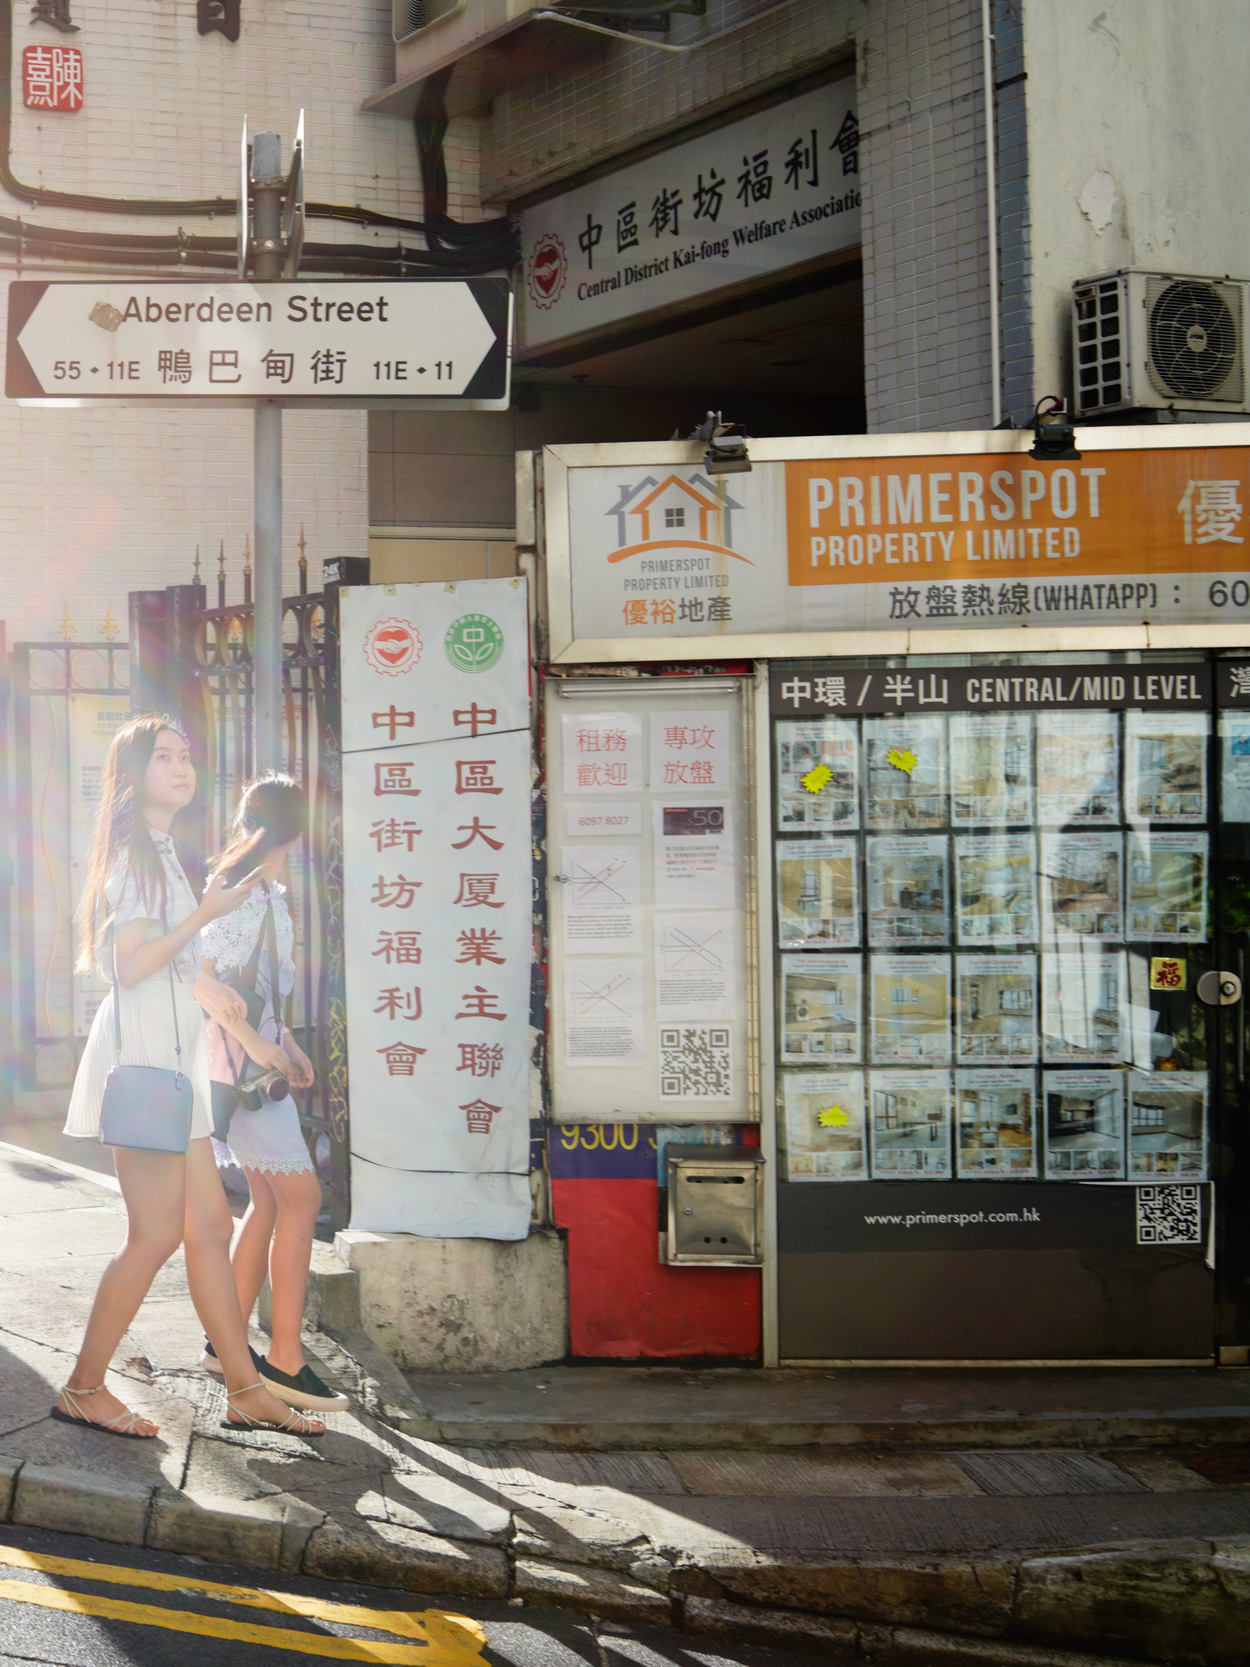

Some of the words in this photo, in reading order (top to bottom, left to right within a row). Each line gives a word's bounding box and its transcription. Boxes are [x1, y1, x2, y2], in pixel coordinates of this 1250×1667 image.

[577, 110, 859, 270] 中區街坊福利會
[577, 270, 621, 301] Central
[624, 257, 670, 286] District
[672, 238, 729, 270] Kai-fong
[732, 218, 787, 248] Welfare
[789, 189, 862, 230] Associatio
[122, 295, 273, 323] Aberdeen
[287, 294, 389, 323] Street
[53, 360, 82, 380] 55
[106, 360, 141, 380] 11E
[157, 348, 348, 385] 鴨巴甸街
[373, 360, 408, 380] 11E
[435, 360, 454, 380] 11
[808, 467, 1106, 528] PRIMERSPOT
[1177, 479, 1245, 545] 優
[811, 531, 955, 567] PROPERTY
[966, 527, 1081, 560] LIMITED
[641, 558, 712, 573] PRIMERSPOT
[624, 577, 680, 591] PROPERTY
[684, 574, 729, 589] LIMITED
[1209, 580, 1250, 608] 60
[622, 595, 732, 626] 優裕地產
[781, 676, 848, 708] 中環
[883, 674, 949, 706] 半山
[966, 676, 1125, 703] CENTRAL/MID
[1133, 675, 1202, 699] LEVEL
[576, 728, 627, 752] 租務
[663, 725, 716, 750] 專攻
[577, 762, 628, 787] 歡迎
[663, 760, 716, 785] 放盤
[578, 817, 602, 826] 6097
[605, 816, 630, 826] 8027
[368, 704, 428, 1078] 中區街坊福利會
[864, 1208, 1041, 1228] www.primerspot.com.hk
